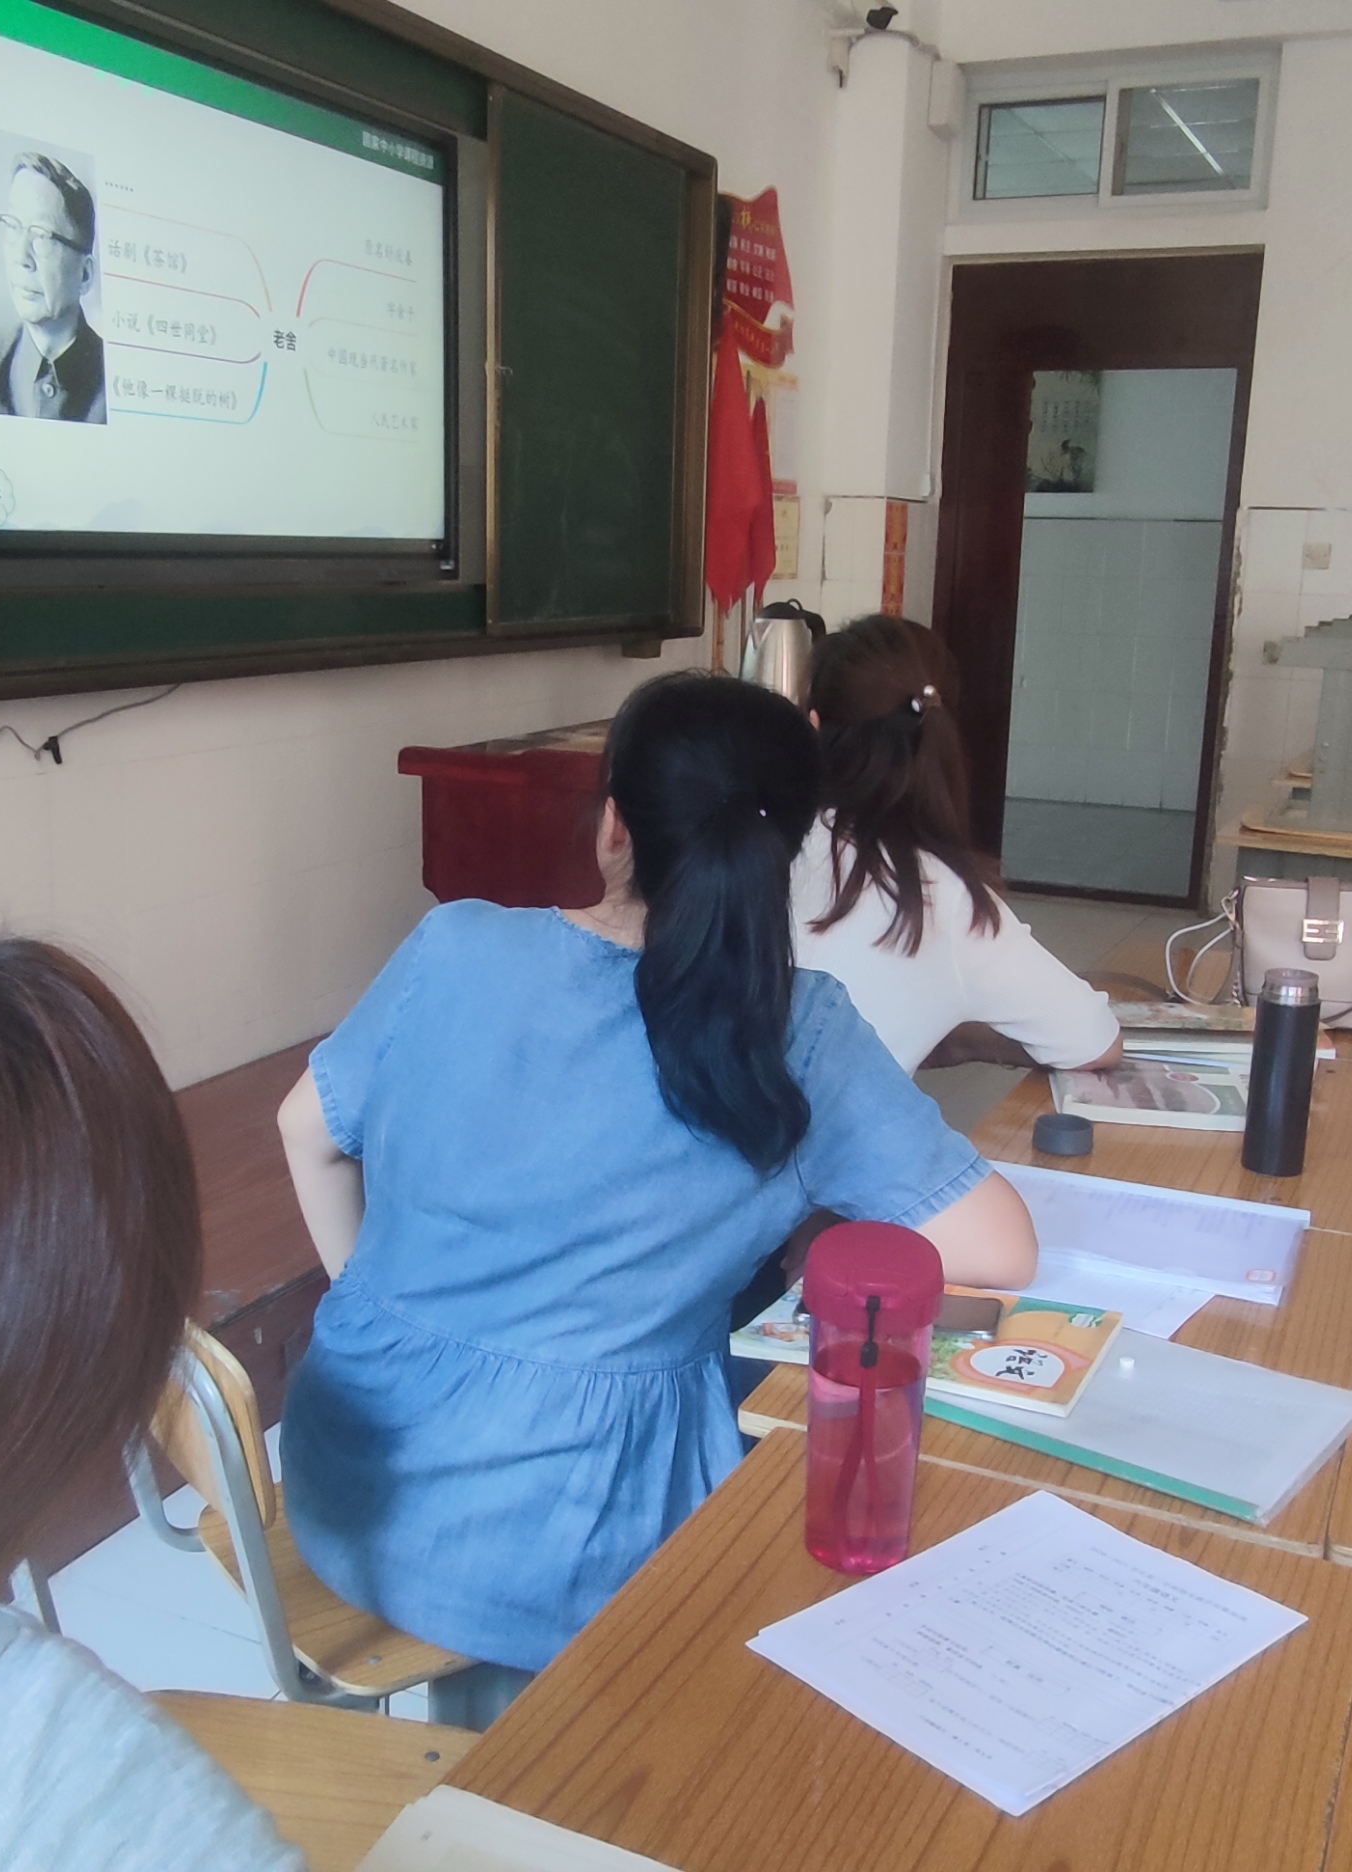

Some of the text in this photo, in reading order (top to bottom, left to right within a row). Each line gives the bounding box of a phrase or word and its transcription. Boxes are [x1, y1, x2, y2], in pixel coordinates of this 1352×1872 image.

[112, 310, 217, 345] 小说《四世同堂》
[272, 330, 297, 351] 老舍
